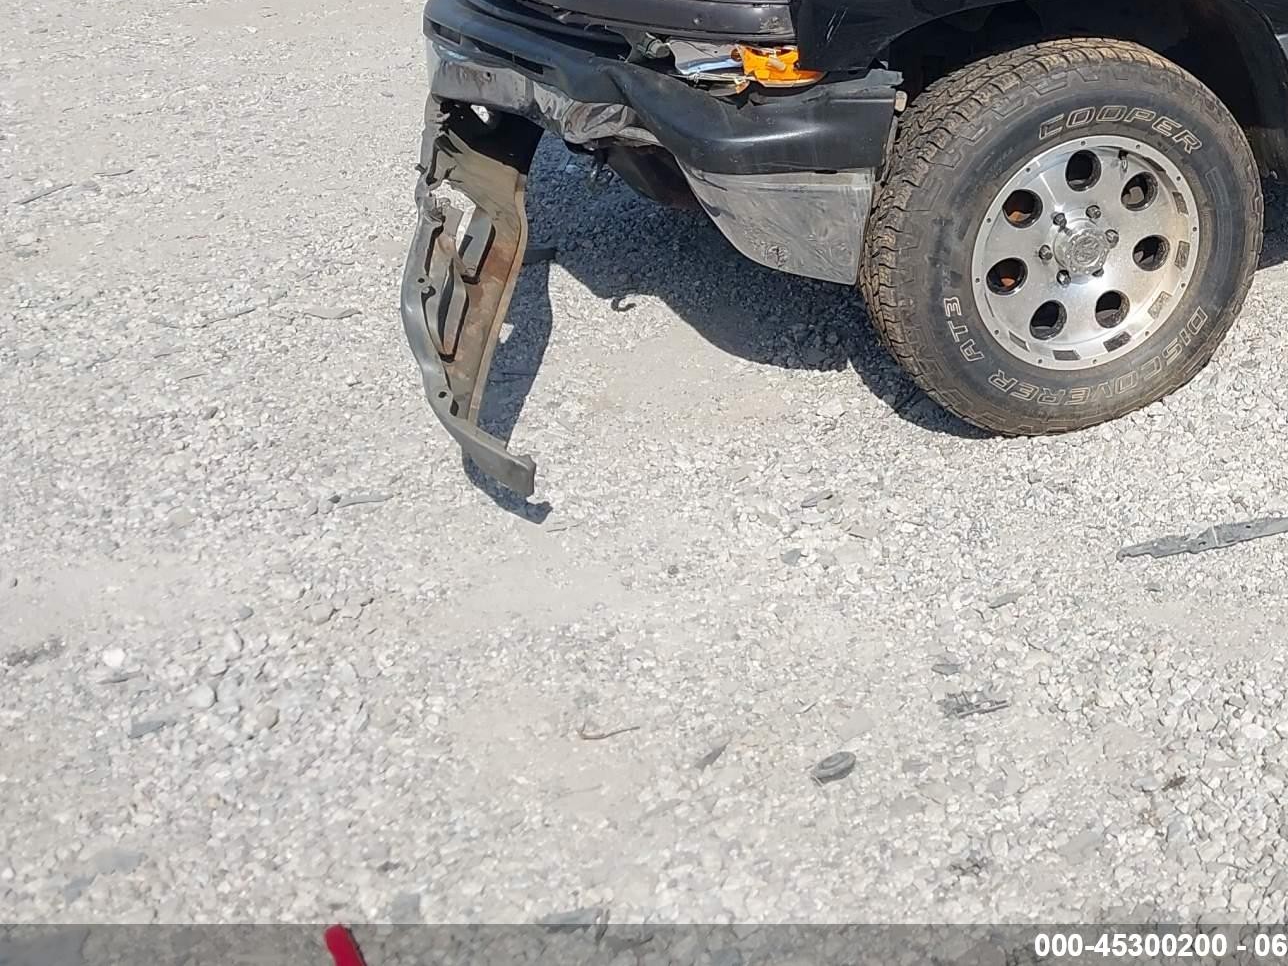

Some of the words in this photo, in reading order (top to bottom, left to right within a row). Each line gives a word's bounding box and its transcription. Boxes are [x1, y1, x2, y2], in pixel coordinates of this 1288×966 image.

[1039, 105, 1203, 154] COOPER
[943, 296, 985, 362] AT3
[988, 305, 1208, 406] DISCOVERER
